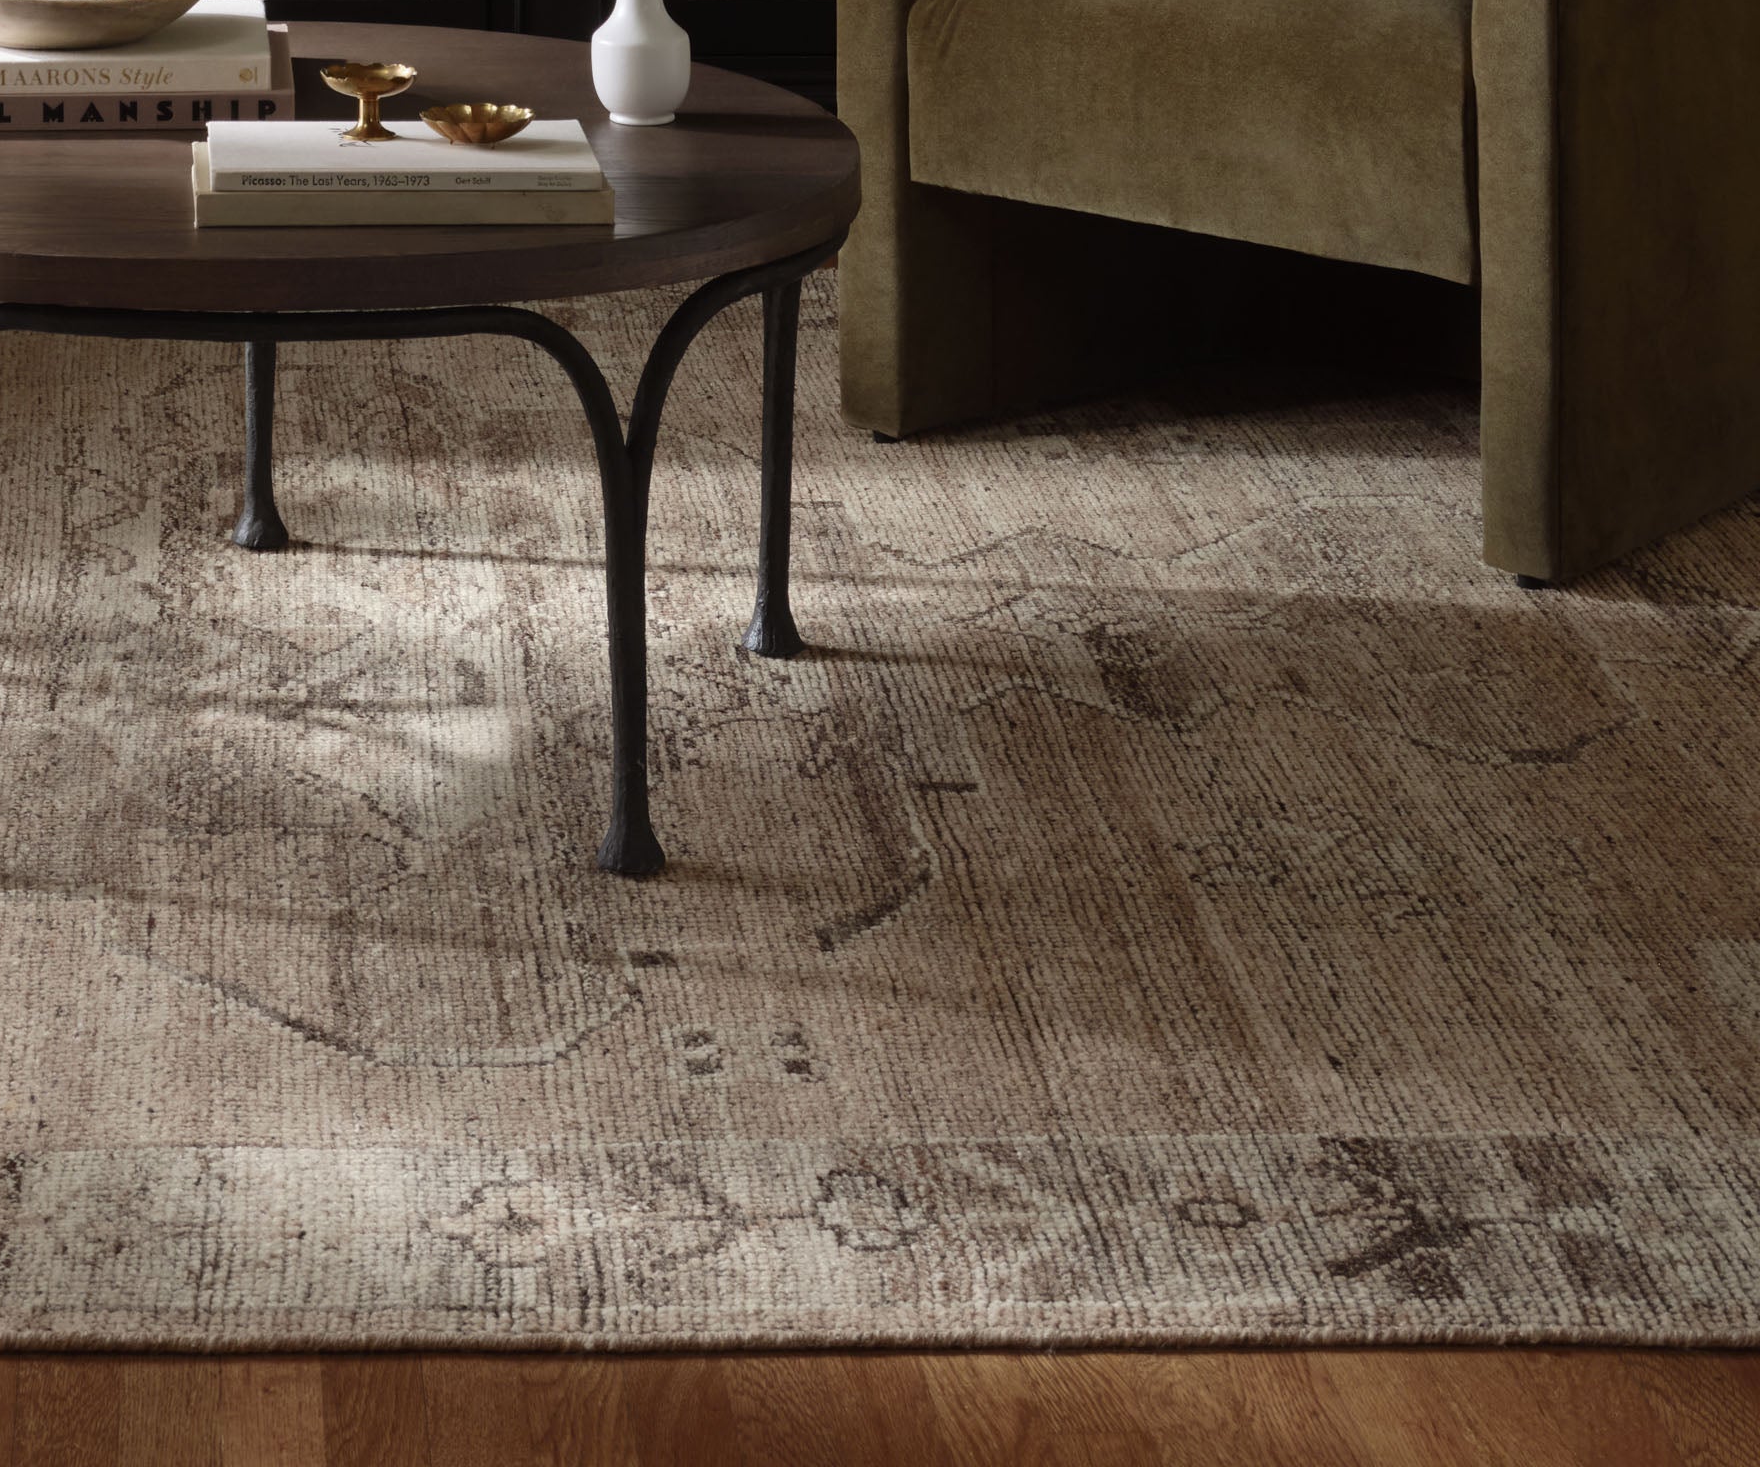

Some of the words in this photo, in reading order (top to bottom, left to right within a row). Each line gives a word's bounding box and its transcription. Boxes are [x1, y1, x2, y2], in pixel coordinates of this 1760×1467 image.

[12, 66, 112, 86] AARONS
[118, 66, 175, 90] Style
[41, 99, 277, 124] MANSHIP
[241, 175, 286, 187] Picasso:
[289, 175, 308, 187] The
[312, 175, 334, 187] Last
[336, 175, 370, 188] Years,
[373, 175, 431, 187] 1963–1973
[455, 177, 471, 185] Gert
[472, 176, 492, 185] Schiff
